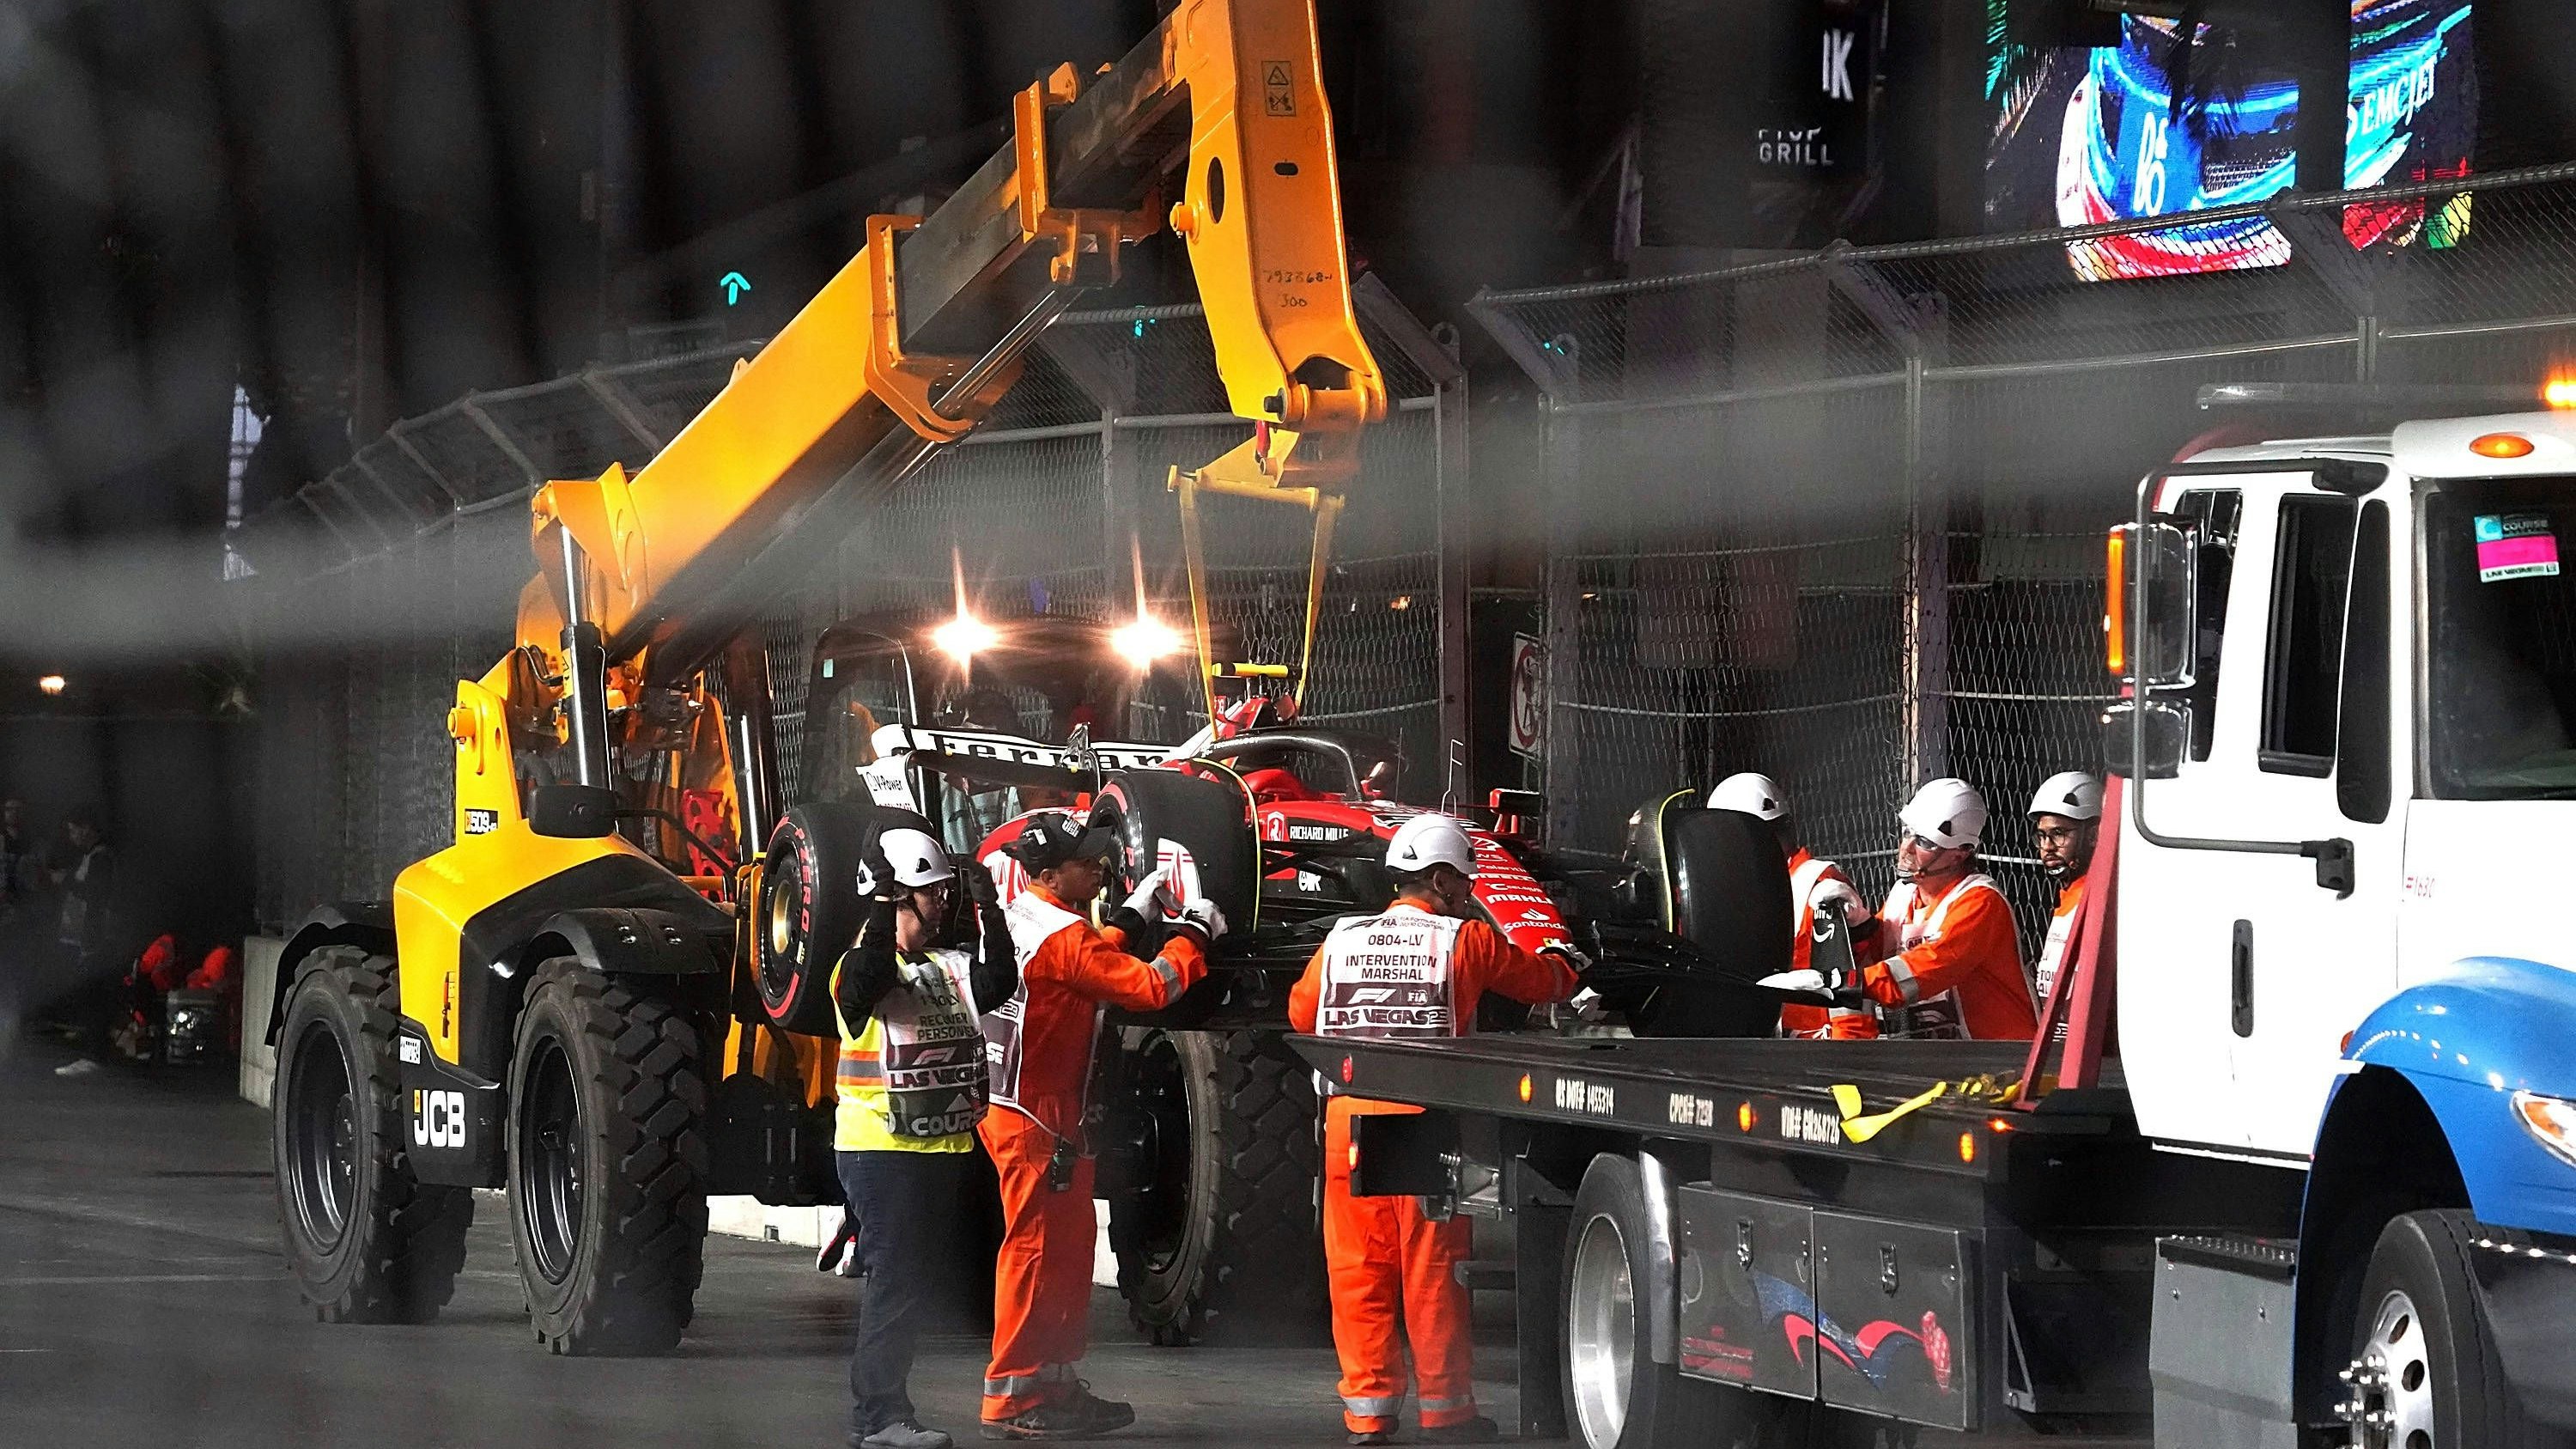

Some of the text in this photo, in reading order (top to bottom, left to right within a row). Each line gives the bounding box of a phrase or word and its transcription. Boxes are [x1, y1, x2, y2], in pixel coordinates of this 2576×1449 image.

[1759, 143, 1834, 165] GRILL
[1289, 825, 1323, 841] RICHARD
[1368, 934, 1425, 946] 0804-LV
[1346, 954, 1438, 968] INTERVENTION
[1361, 968, 1425, 981] MARSHAL
[1325, 1009, 1360, 1026] LAS
[413, 1088, 465, 1148] JCB
